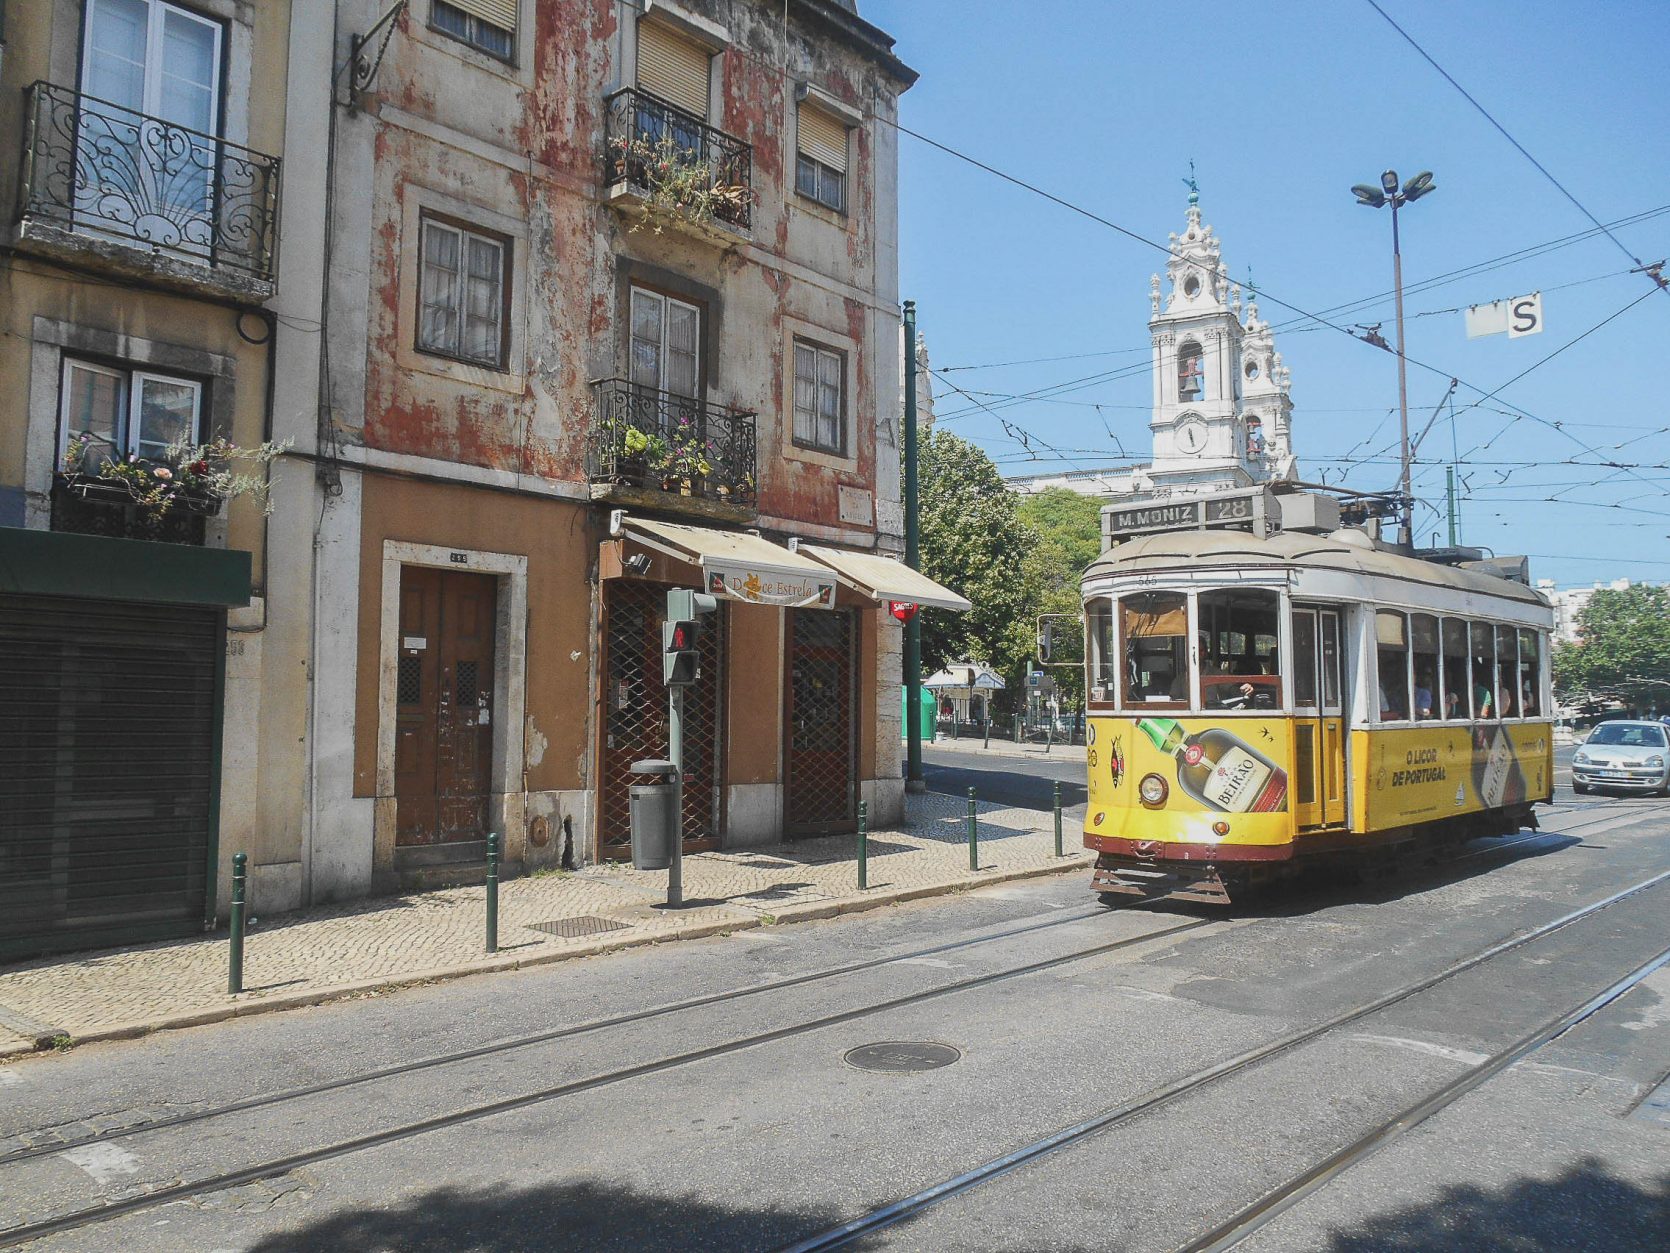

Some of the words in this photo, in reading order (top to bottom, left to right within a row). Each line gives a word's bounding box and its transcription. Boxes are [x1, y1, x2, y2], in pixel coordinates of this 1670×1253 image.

[1513, 301, 1537, 332] S
[1218, 501, 1247, 519] 28
[733, 574, 773, 597] Dce
[777, 579, 812, 597] Estrela
[1407, 751, 1413, 765] O
[1414, 748, 1437, 764] LICOR
[1218, 759, 1255, 806] BEIRÃO
[1392, 772, 1403, 787] DE
[1404, 767, 1446, 785] PORTUGAL
